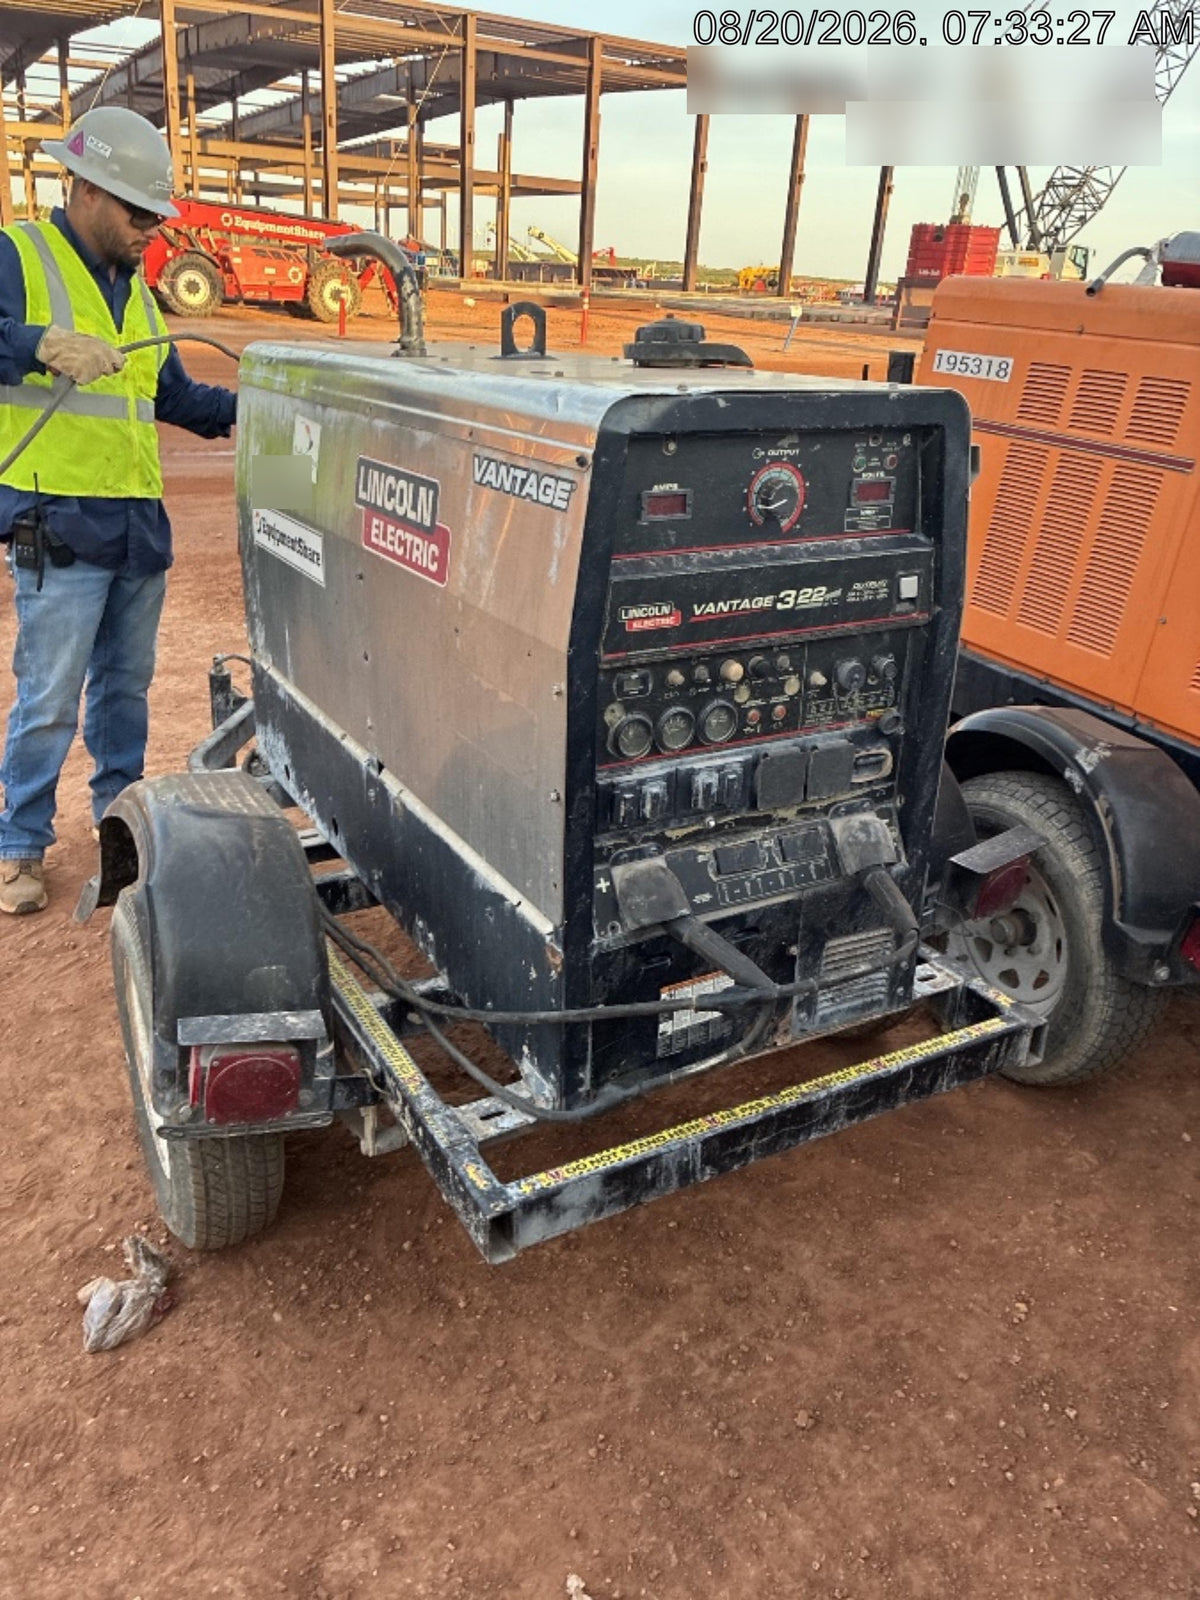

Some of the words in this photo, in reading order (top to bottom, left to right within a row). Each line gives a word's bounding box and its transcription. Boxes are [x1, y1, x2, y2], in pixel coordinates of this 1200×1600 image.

[936, 353, 1010, 379] 195318
[357, 465, 435, 528] LINCOLN
[473, 457, 573, 510] VANTAGE
[370, 516, 440, 573] ELECTRIC
[621, 604, 672, 619] LINCOLN
[691, 596, 774, 617] VANTAGE
[776, 586, 828, 610] 322
[566, 1163, 588, 1174] DO
[590, 1151, 619, 1167] NOT
[625, 1135, 668, 1155] STAND
